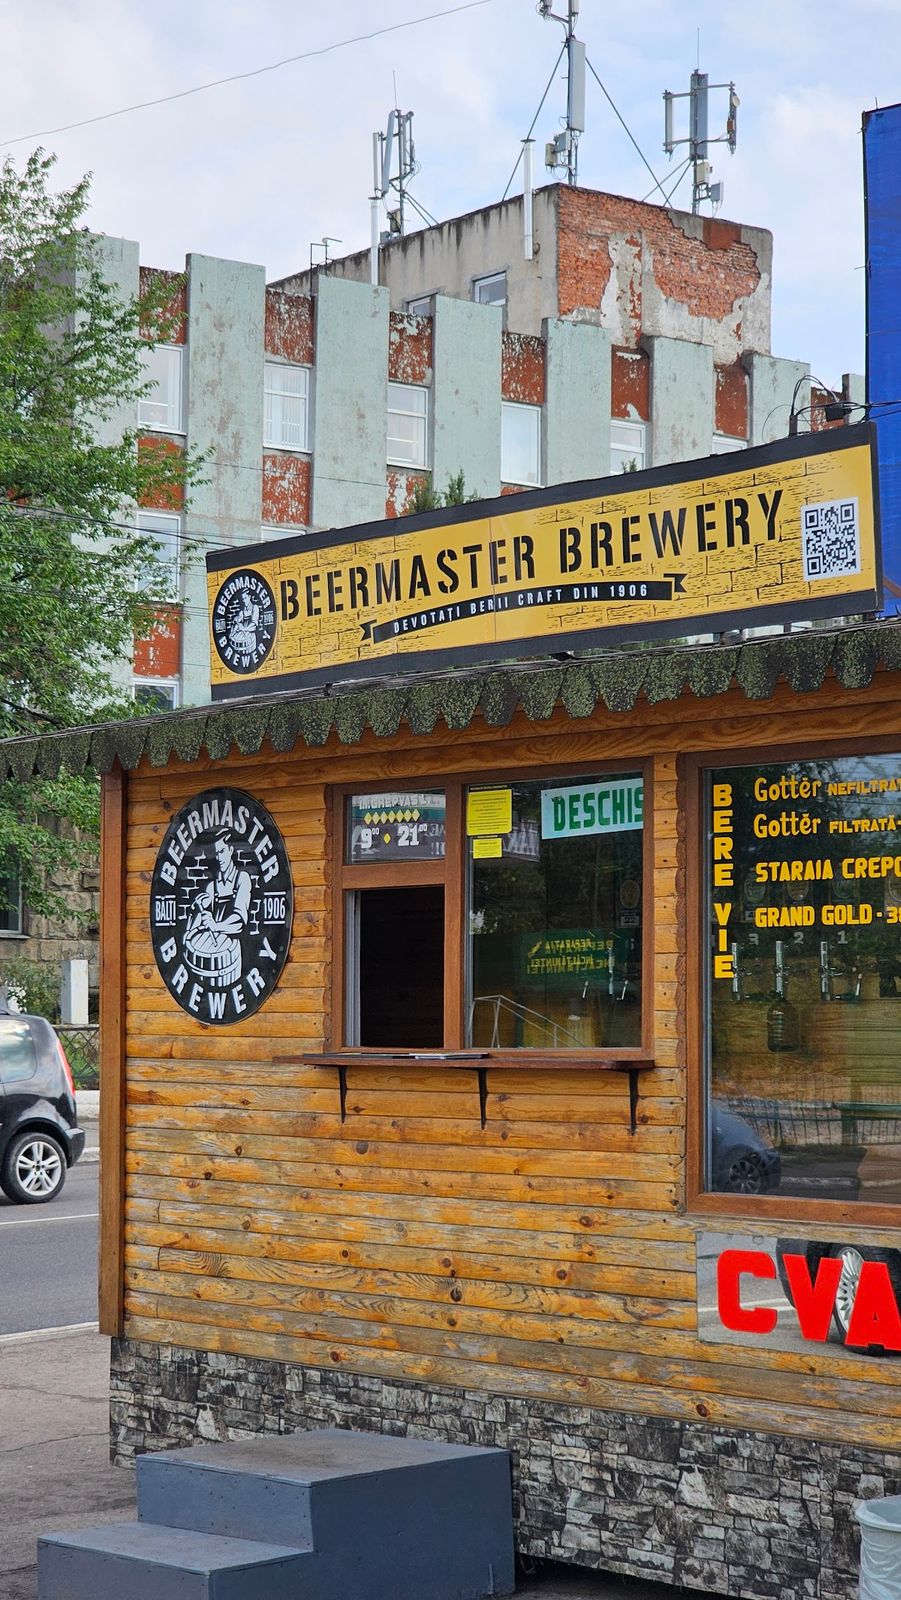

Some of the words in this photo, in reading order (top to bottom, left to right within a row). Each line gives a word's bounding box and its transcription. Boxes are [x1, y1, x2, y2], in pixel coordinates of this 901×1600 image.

[280, 535, 536, 621] BEERMASTER
[559, 489, 783, 574] BREWERY
[217, 576, 271, 616] BEERMASTER
[470, 597, 509, 615] BERII
[518, 588, 562, 605] CRAFT
[573, 586, 599, 600] DIN
[610, 584, 648, 597] 1906
[218, 630, 271, 668] BREWERY
[160, 799, 280, 886] BEERMASTER
[713, 783, 734, 887] BERE
[755, 859, 834, 883] STARAIA
[263, 897, 286, 920] 1906
[755, 905, 815, 928] GRAND
[713, 903, 735, 979] VIE
[793, 931, 804, 945] 2
[837, 930, 848, 945] 1
[160, 936, 278, 1019] BREWERY
[717, 1249, 901, 1351] CVA
